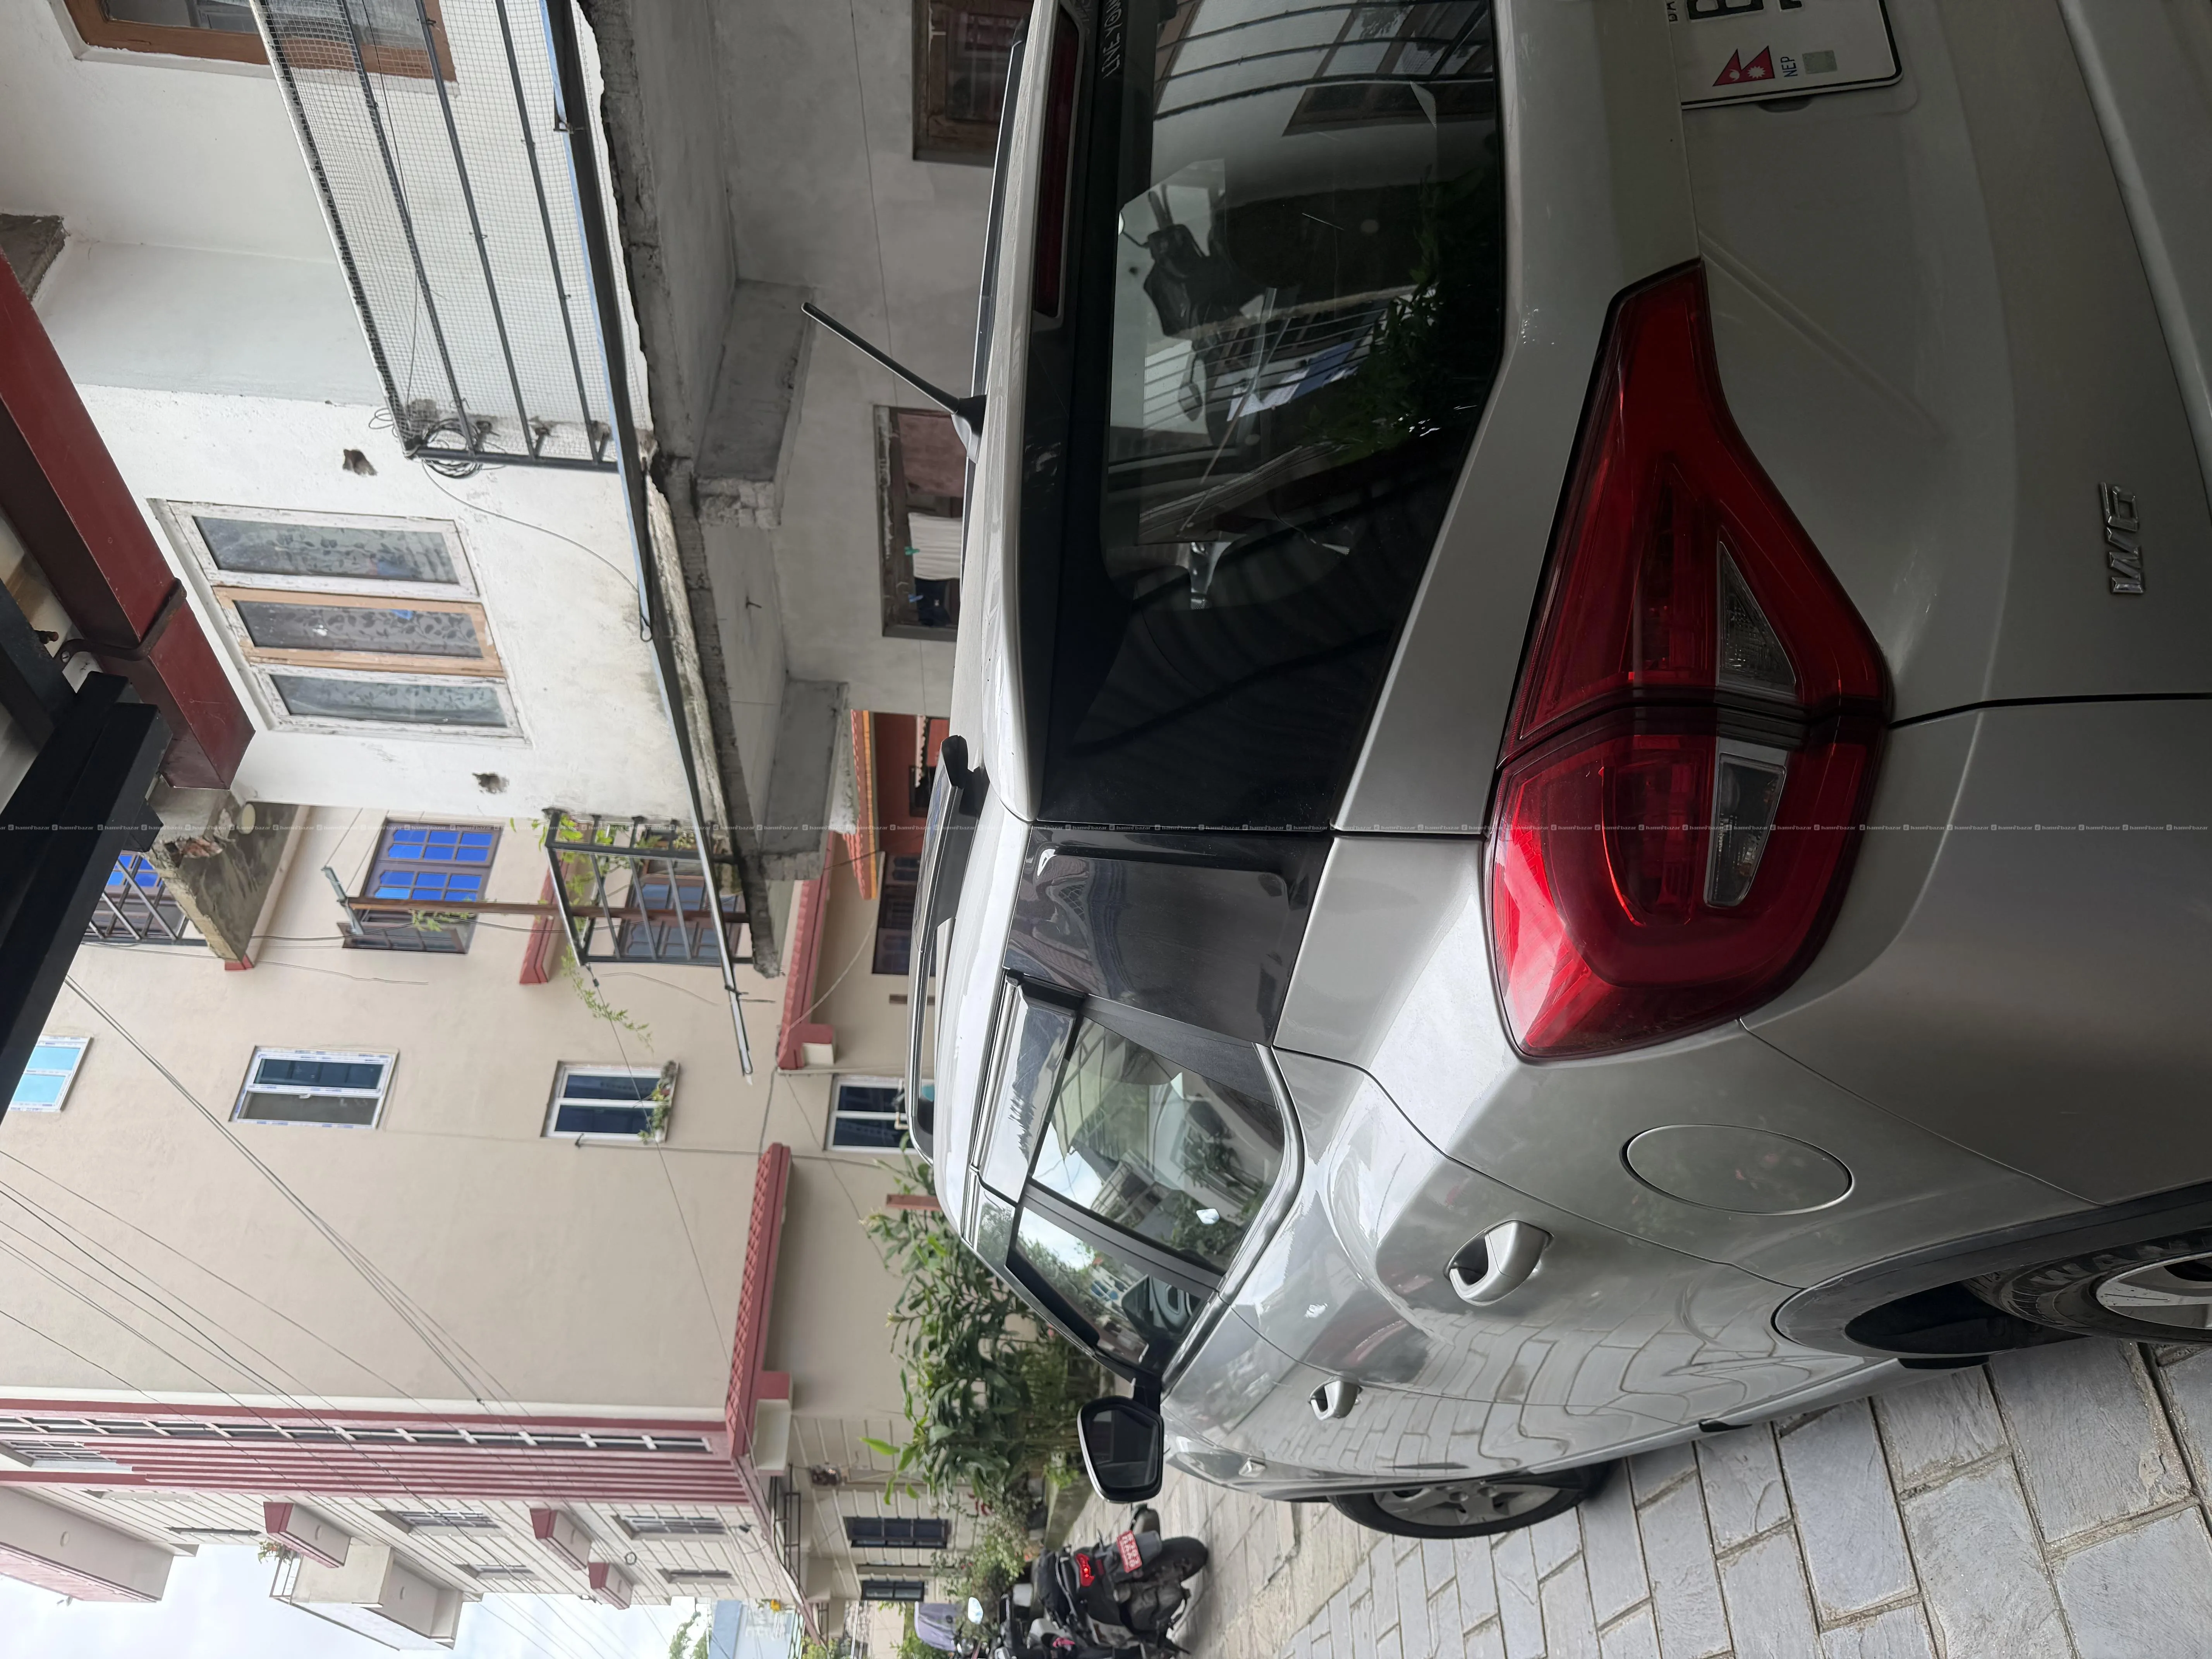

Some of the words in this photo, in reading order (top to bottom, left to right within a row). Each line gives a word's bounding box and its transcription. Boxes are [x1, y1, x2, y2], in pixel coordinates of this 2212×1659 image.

[1101, 32, 1121, 79] LIVE
[1780, 57, 1798, 77] NEP
[2099, 482, 2145, 594] W6
